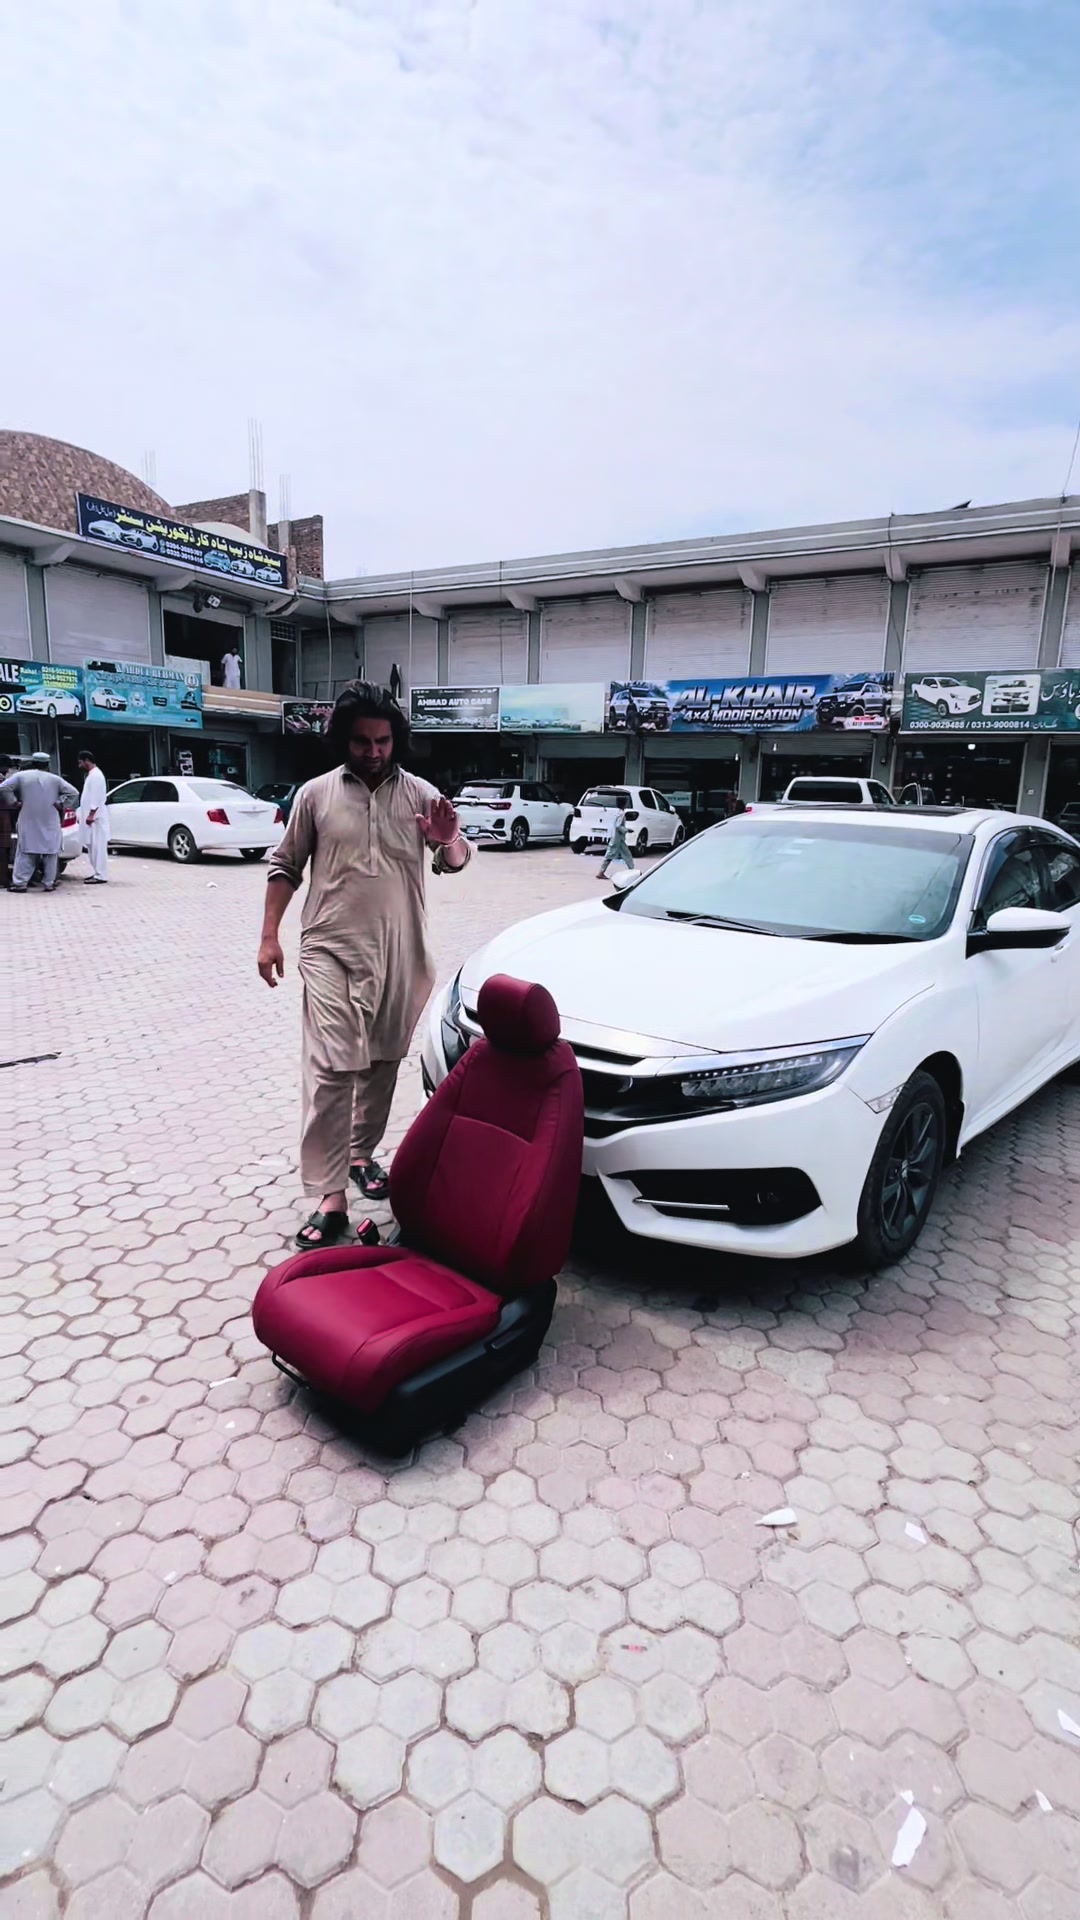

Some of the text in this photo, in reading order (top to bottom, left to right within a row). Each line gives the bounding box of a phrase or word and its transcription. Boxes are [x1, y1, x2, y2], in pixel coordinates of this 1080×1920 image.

[674, 682, 816, 708] AL-KHAIR
[417, 697, 492, 706] AHMAD AUTO CARE
[683, 708, 802, 721] 4x4 MODIFICATION
[970, 720, 1030, 729] 0313-9000814
